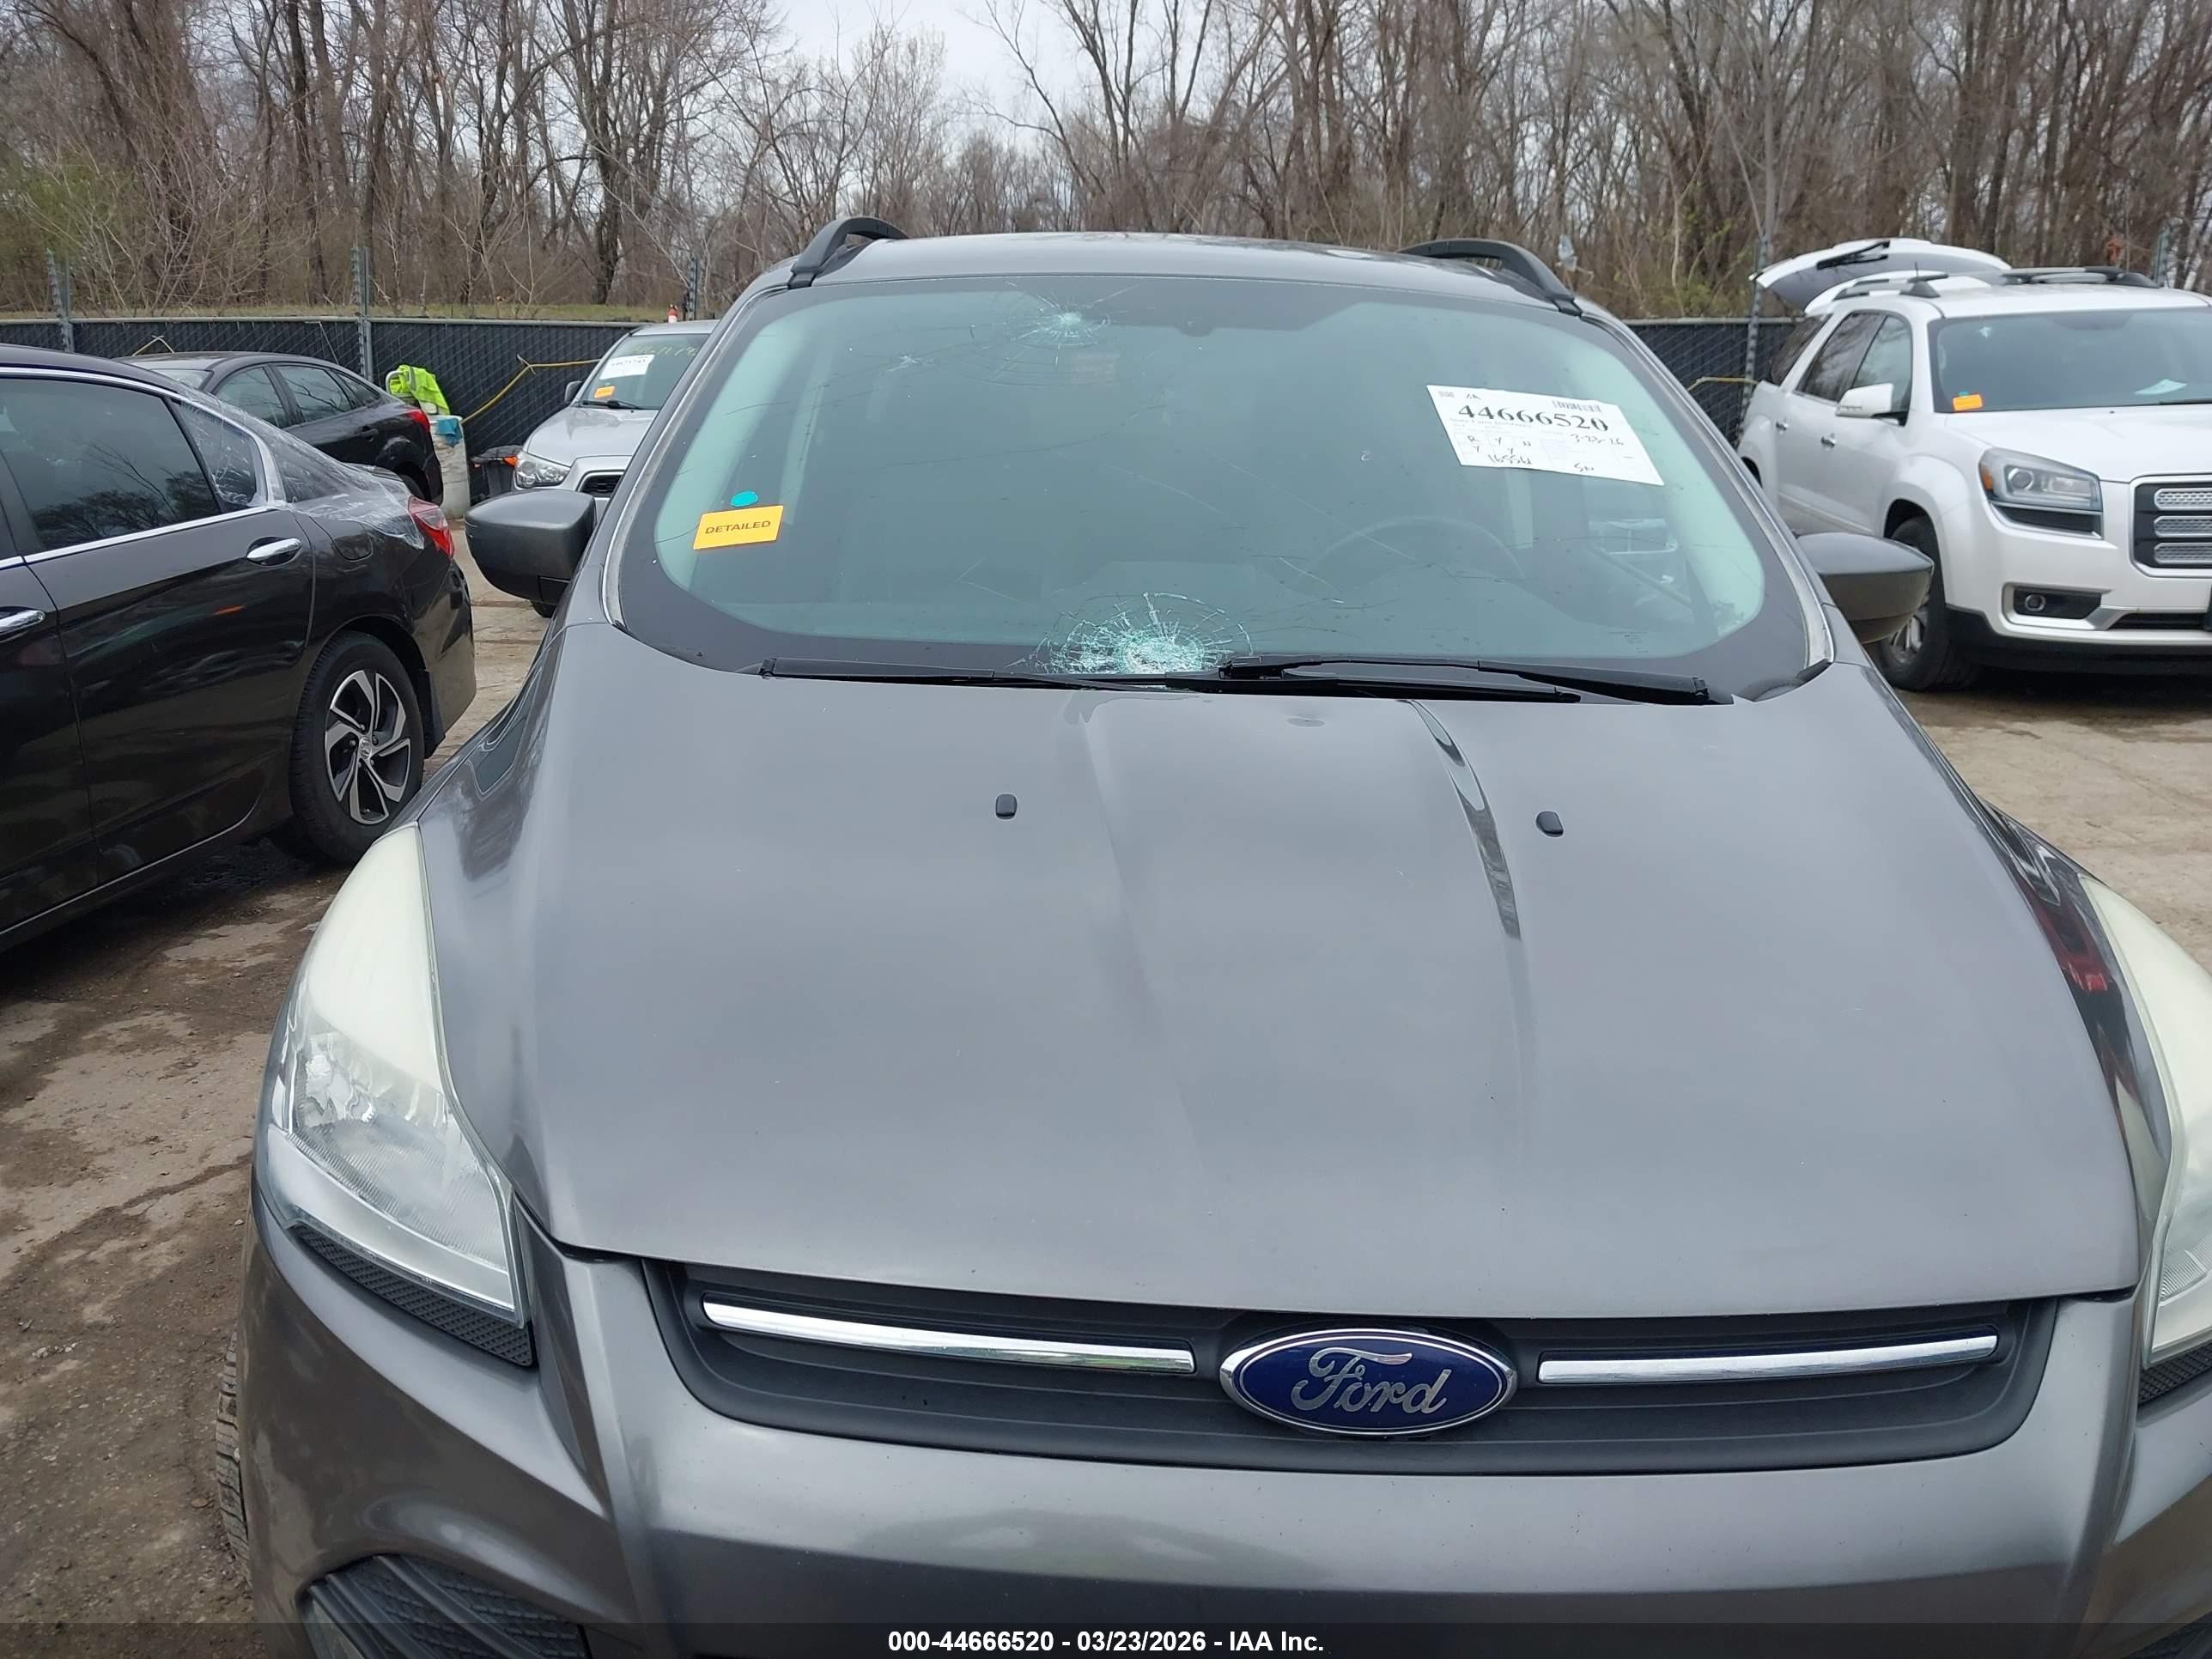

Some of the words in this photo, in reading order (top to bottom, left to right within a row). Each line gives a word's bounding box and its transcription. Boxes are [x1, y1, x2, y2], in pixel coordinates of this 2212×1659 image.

[1458, 404, 1608, 431] 44666520
[705, 520, 771, 534] DETAILED
[1290, 1347, 1452, 1414] Ford
